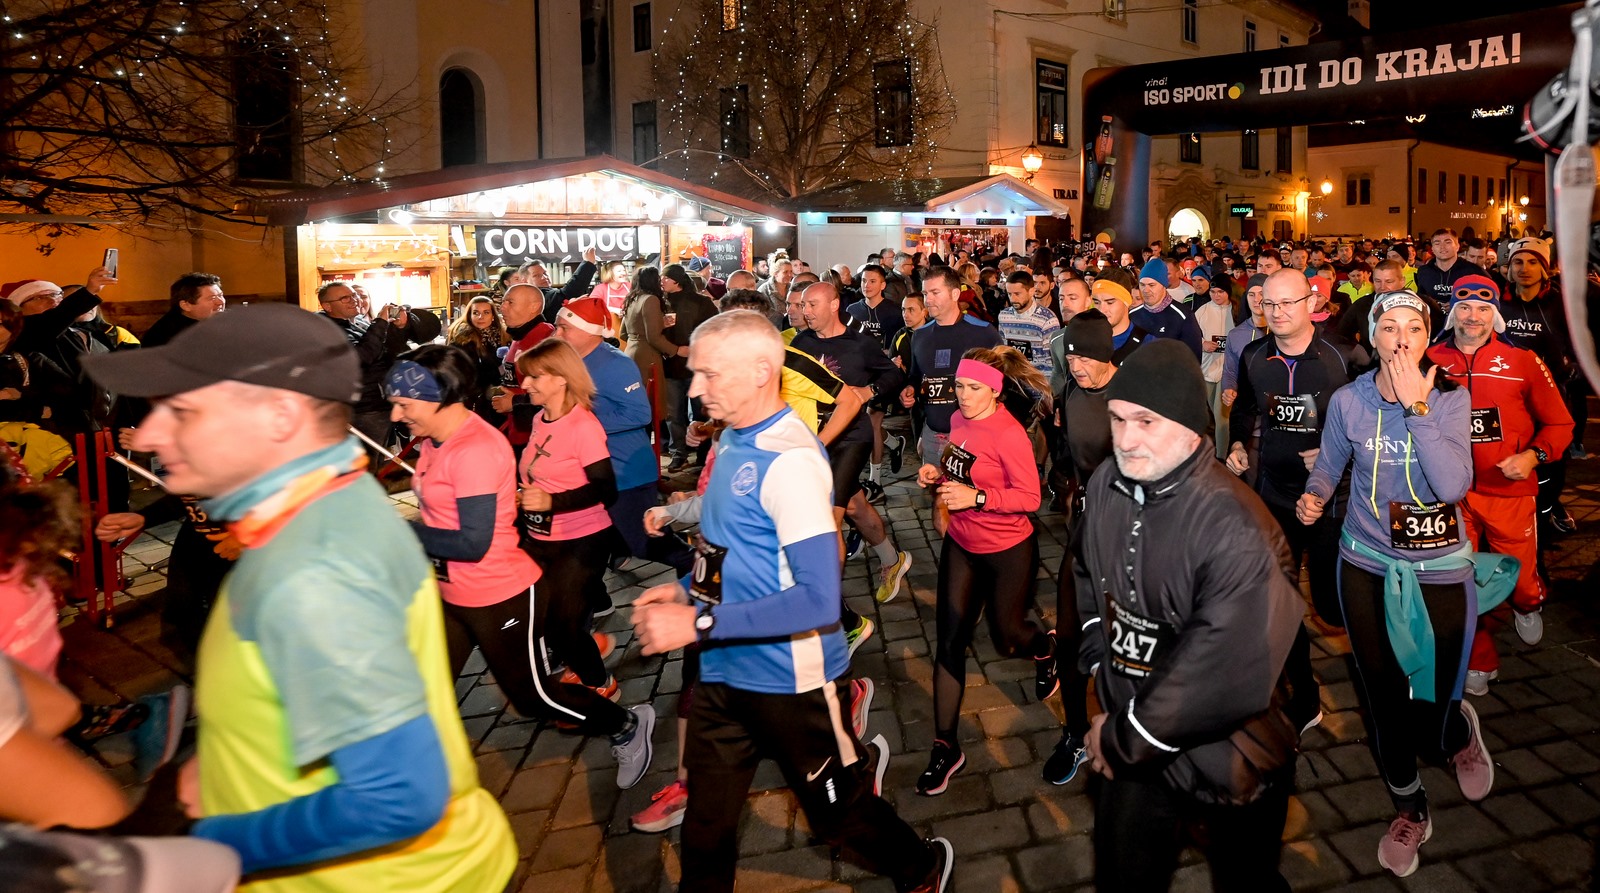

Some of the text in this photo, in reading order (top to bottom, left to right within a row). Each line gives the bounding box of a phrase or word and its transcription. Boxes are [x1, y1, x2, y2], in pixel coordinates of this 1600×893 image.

[1259, 32, 1521, 95] IDI DO KRAJA!
[1144, 83, 1228, 106] ISO SPORT
[1053, 189, 1078, 200] URAR
[484, 228, 634, 256] CORN DOG
[928, 384, 943, 398] 37
[1277, 405, 1305, 422] 397
[1384, 440, 1415, 454] NY
[945, 455, 964, 479] 441
[1405, 514, 1447, 537] 346
[1111, 620, 1158, 663] 247
